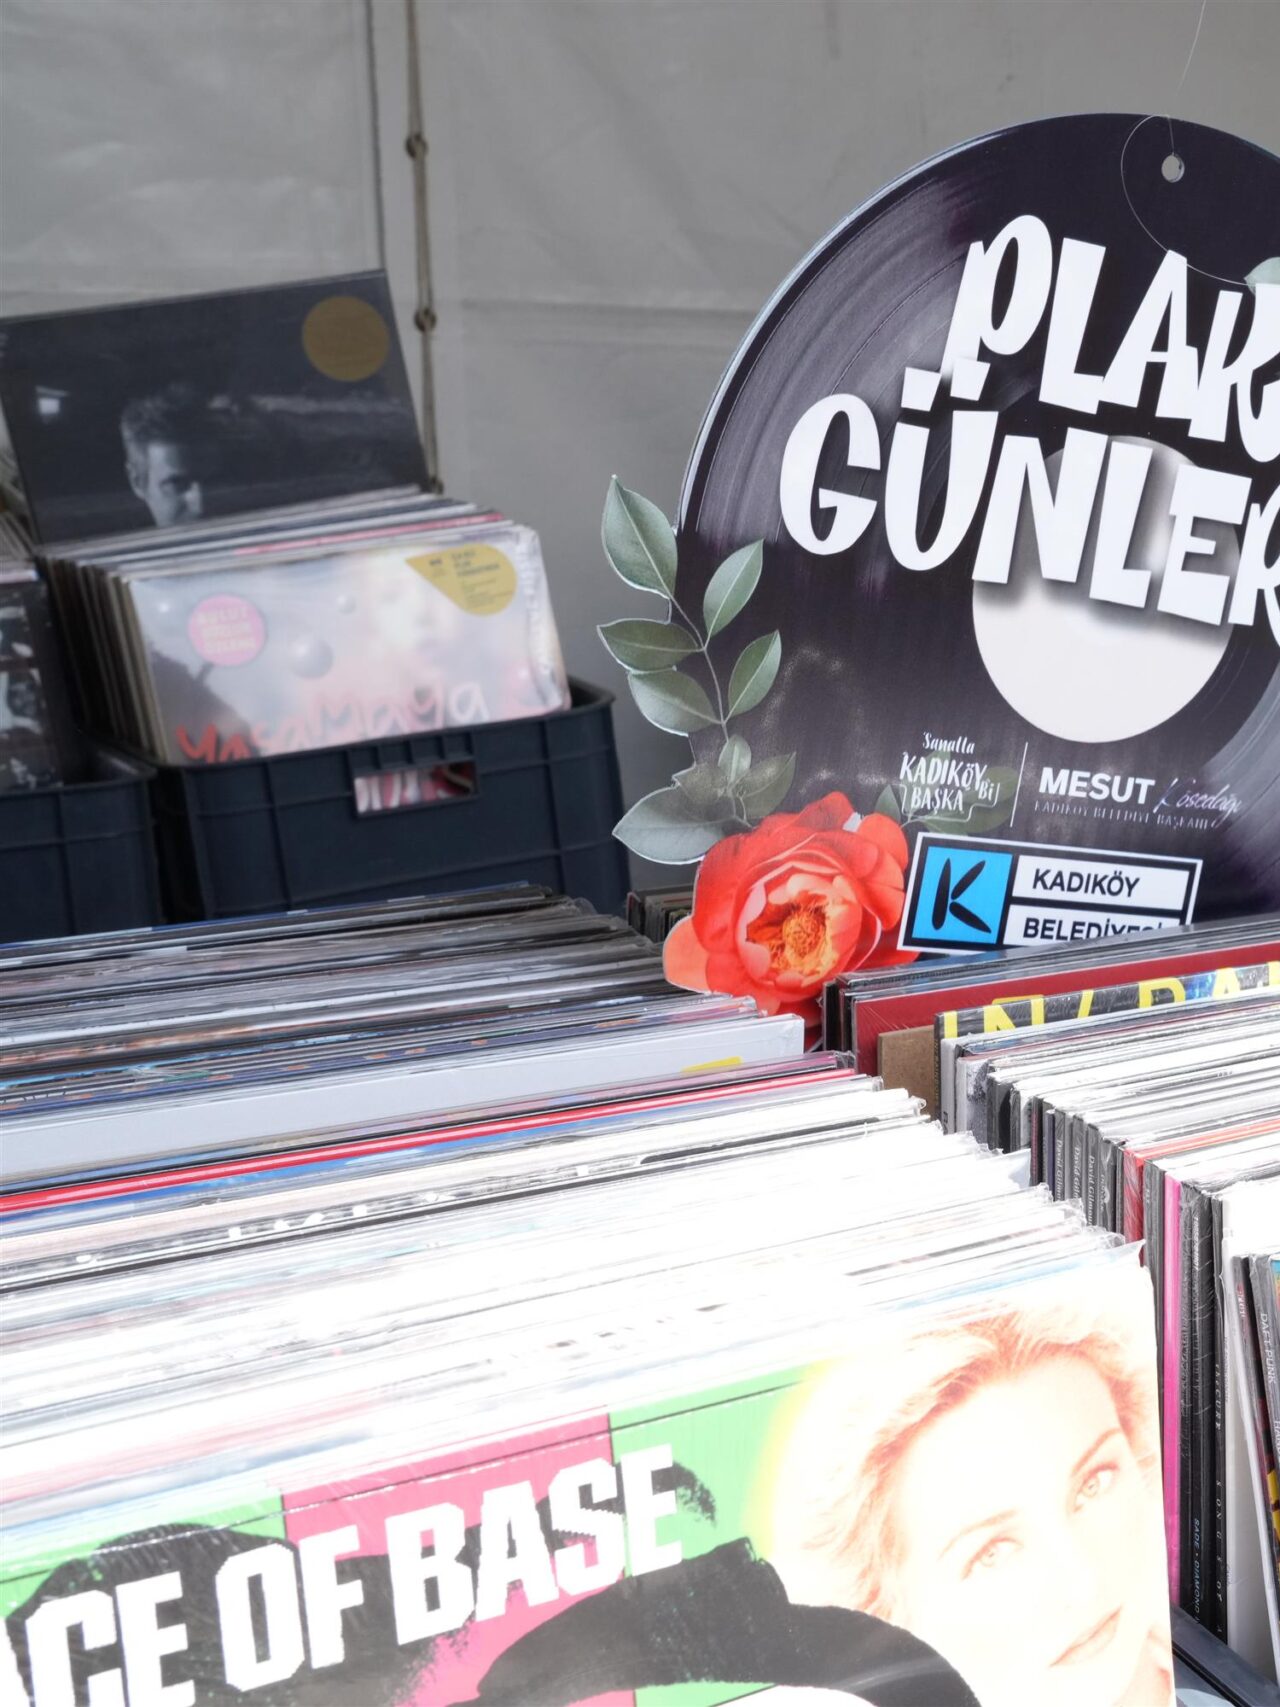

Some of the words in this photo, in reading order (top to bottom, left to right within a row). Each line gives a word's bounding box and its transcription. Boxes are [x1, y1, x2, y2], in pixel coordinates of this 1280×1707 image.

[899, 751, 988, 791] KADIKÖY
[1039, 766, 1156, 804] MESUT
[911, 786, 965, 815] BAŞKA
[1032, 867, 1140, 898] KADIKÖY
[1055, 1139, 1064, 1167] David
[1072, 1147, 1081, 1175] David
[1088, 1155, 1096, 1184] David
[1260, 1313, 1271, 1348] DAFT
[1265, 1350, 1277, 1384] PUNK
[215, 1525, 364, 1691] OF
[384, 1444, 684, 1646] BASE
